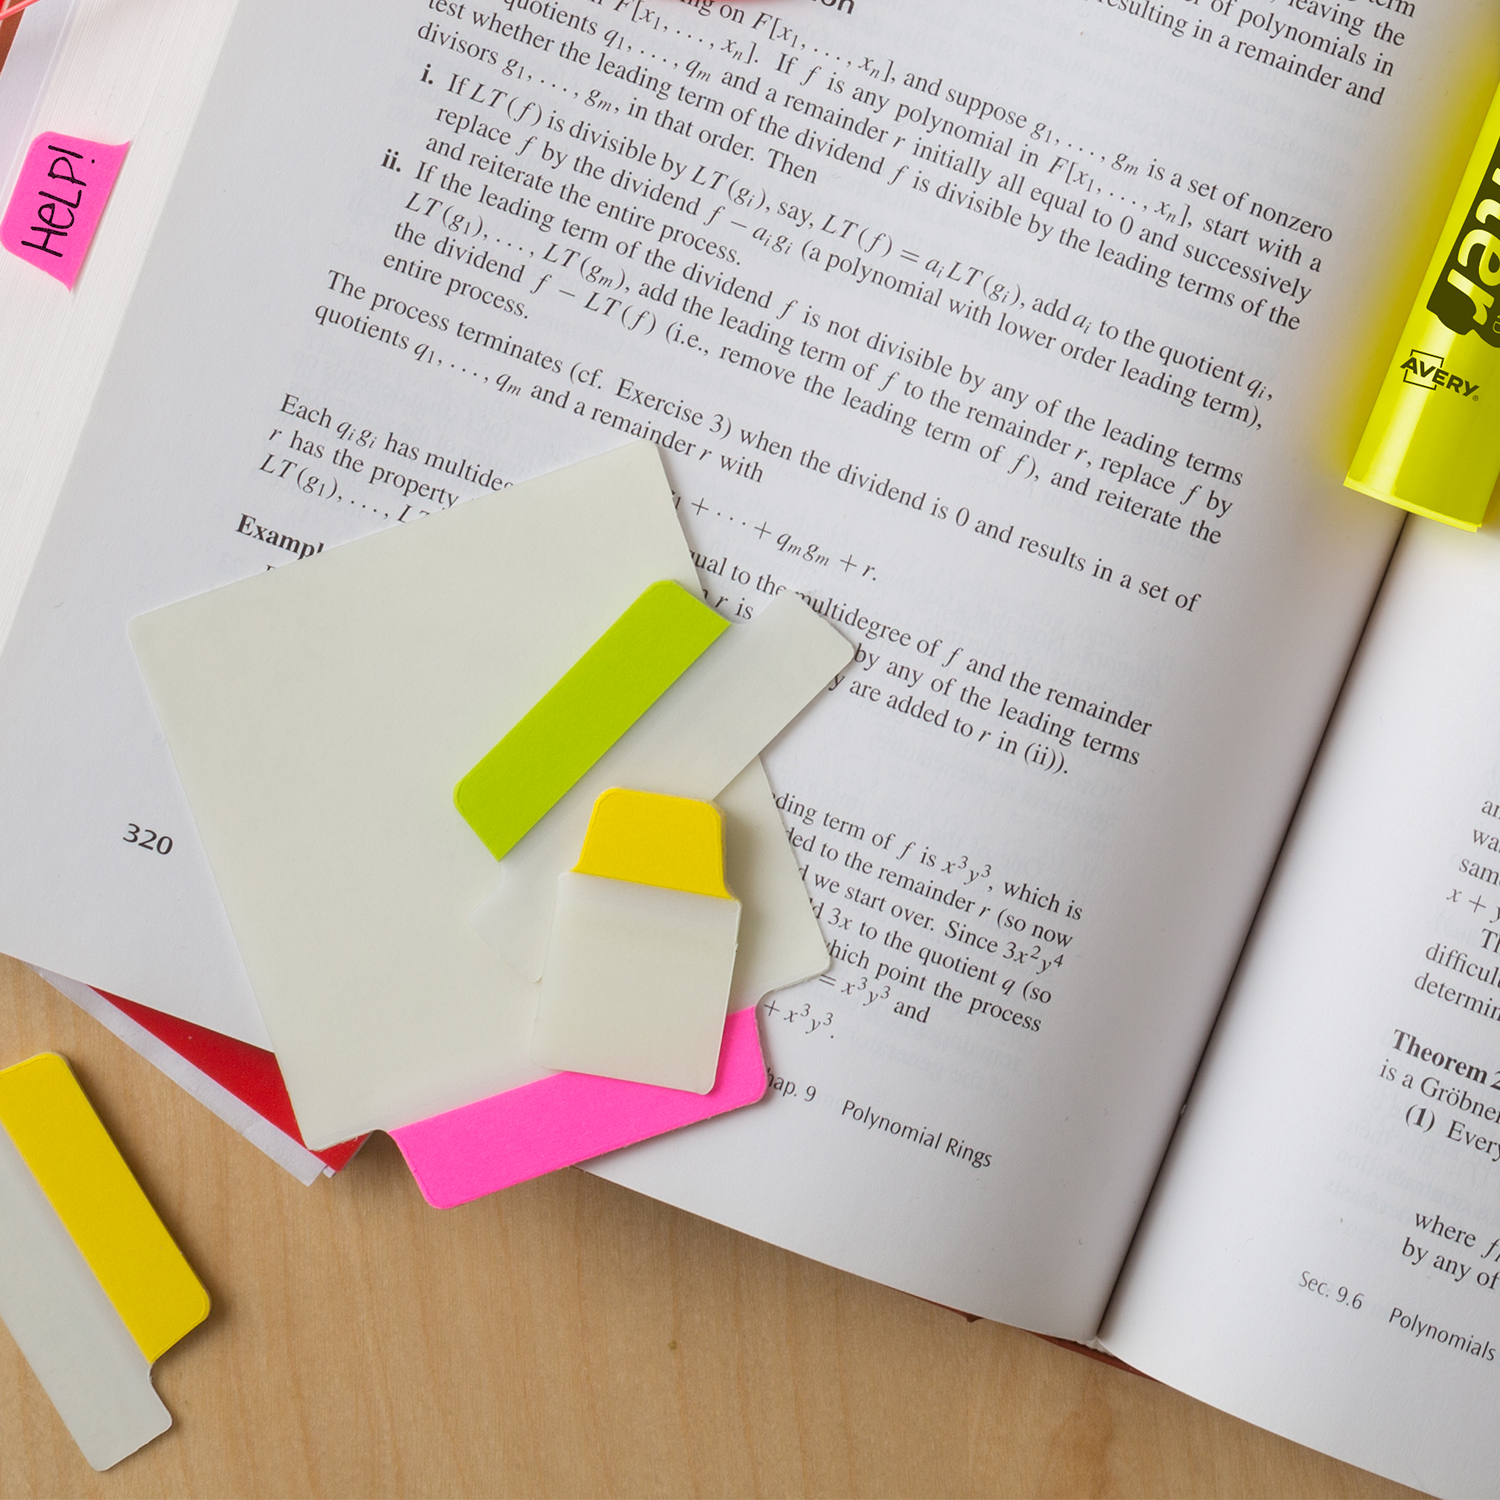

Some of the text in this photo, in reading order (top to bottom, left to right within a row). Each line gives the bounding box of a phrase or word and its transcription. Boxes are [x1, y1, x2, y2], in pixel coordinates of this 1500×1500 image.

[419, 63, 434, 86] i.
[380, 148, 402, 173] ii.
[382, 254, 528, 320] entire process.
[327, 269, 564, 374] The process terminates
[280, 393, 331, 431] Each
[122, 822, 174, 856] 320
[1392, 1029, 1487, 1086] Theorem
[767, 1068, 993, 1169] hap. 9 Polynomial Rings
[1405, 1104, 1436, 1134] (1)
[1298, 1270, 1331, 1298] Sec.
[1335, 1286, 1365, 1310] 9.6
[1388, 1306, 1497, 1362] Polynomials
